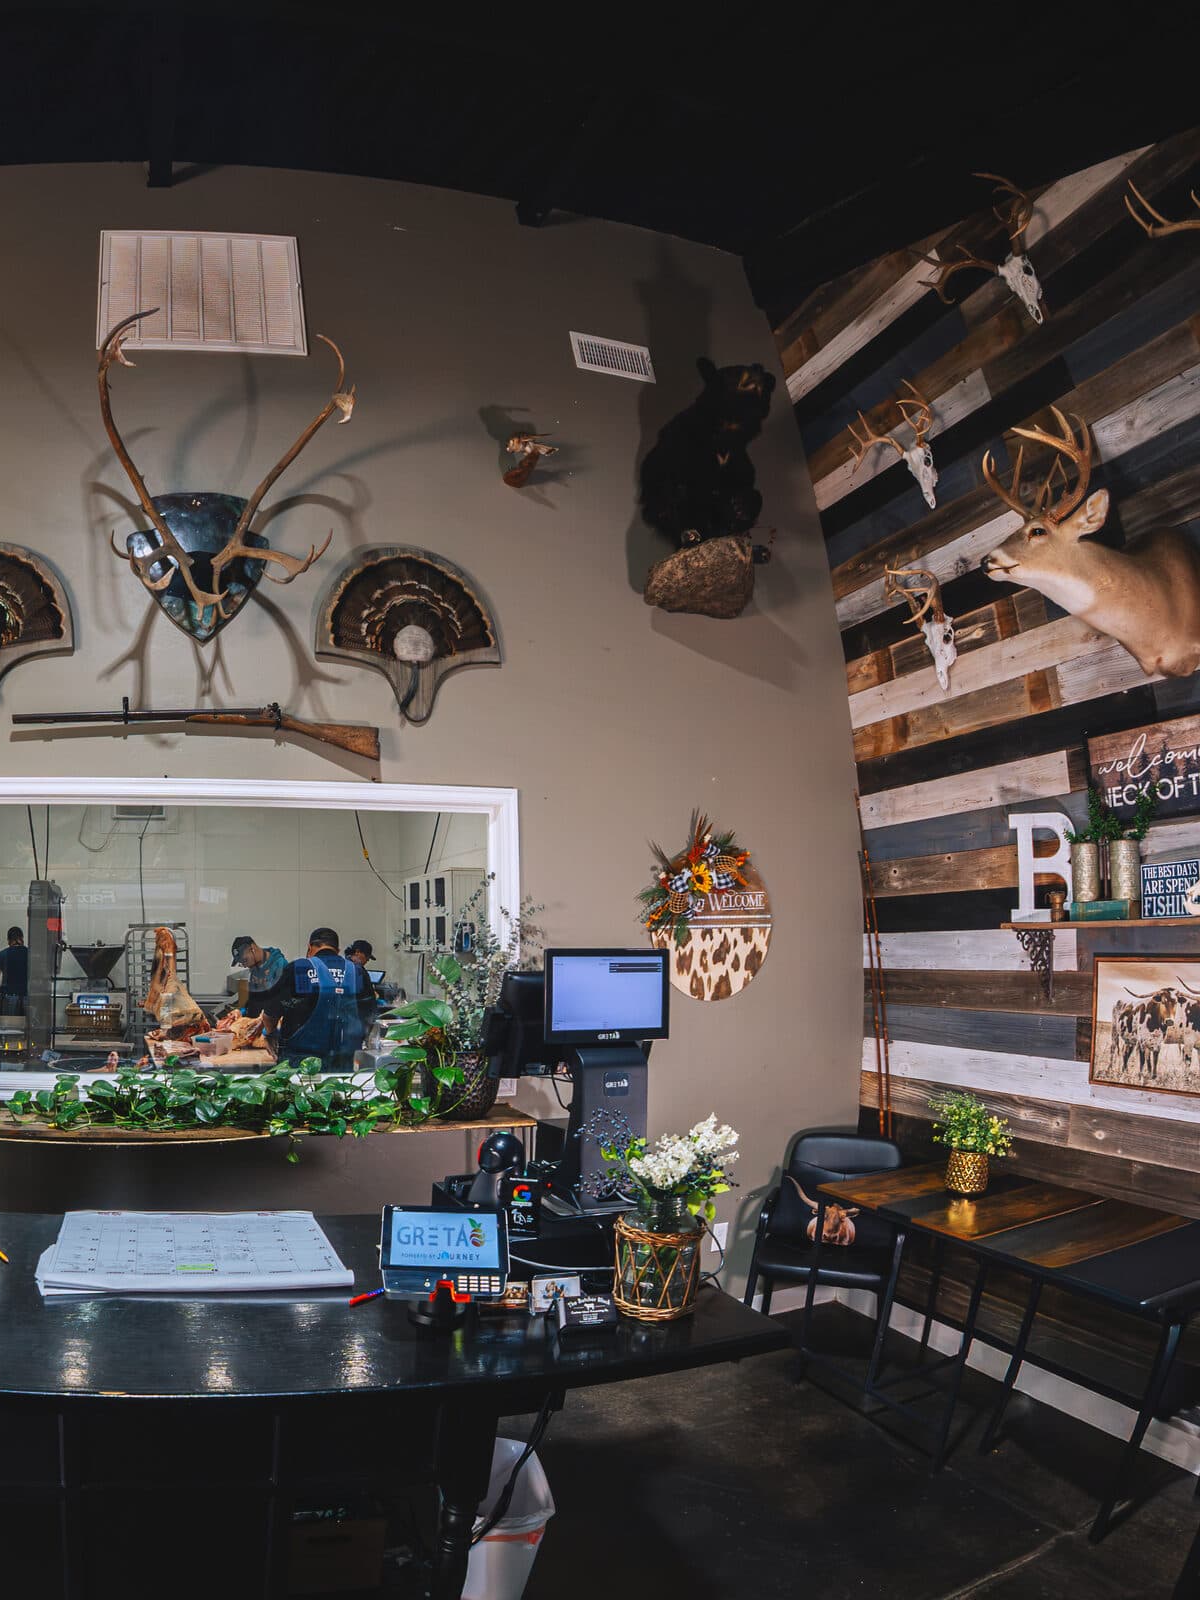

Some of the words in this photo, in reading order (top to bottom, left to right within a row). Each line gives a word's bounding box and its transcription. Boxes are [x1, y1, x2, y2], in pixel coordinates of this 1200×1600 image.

[1098, 733, 1200, 778] welcom
[1157, 775, 1185, 800] OF
[1188, 773, 1200, 796] T
[1008, 812, 1075, 922] B
[1143, 866, 1158, 880] THE
[1158, 865, 1176, 878] BEST
[1176, 862, 1198, 877] DAYS
[1144, 879, 1165, 895] ARE
[707, 892, 765, 911] WELCOME
[1144, 894, 1190, 916] FISHIN
[397, 1223, 470, 1248] GRETA
[436, 1250, 481, 1261] JOURNEY
